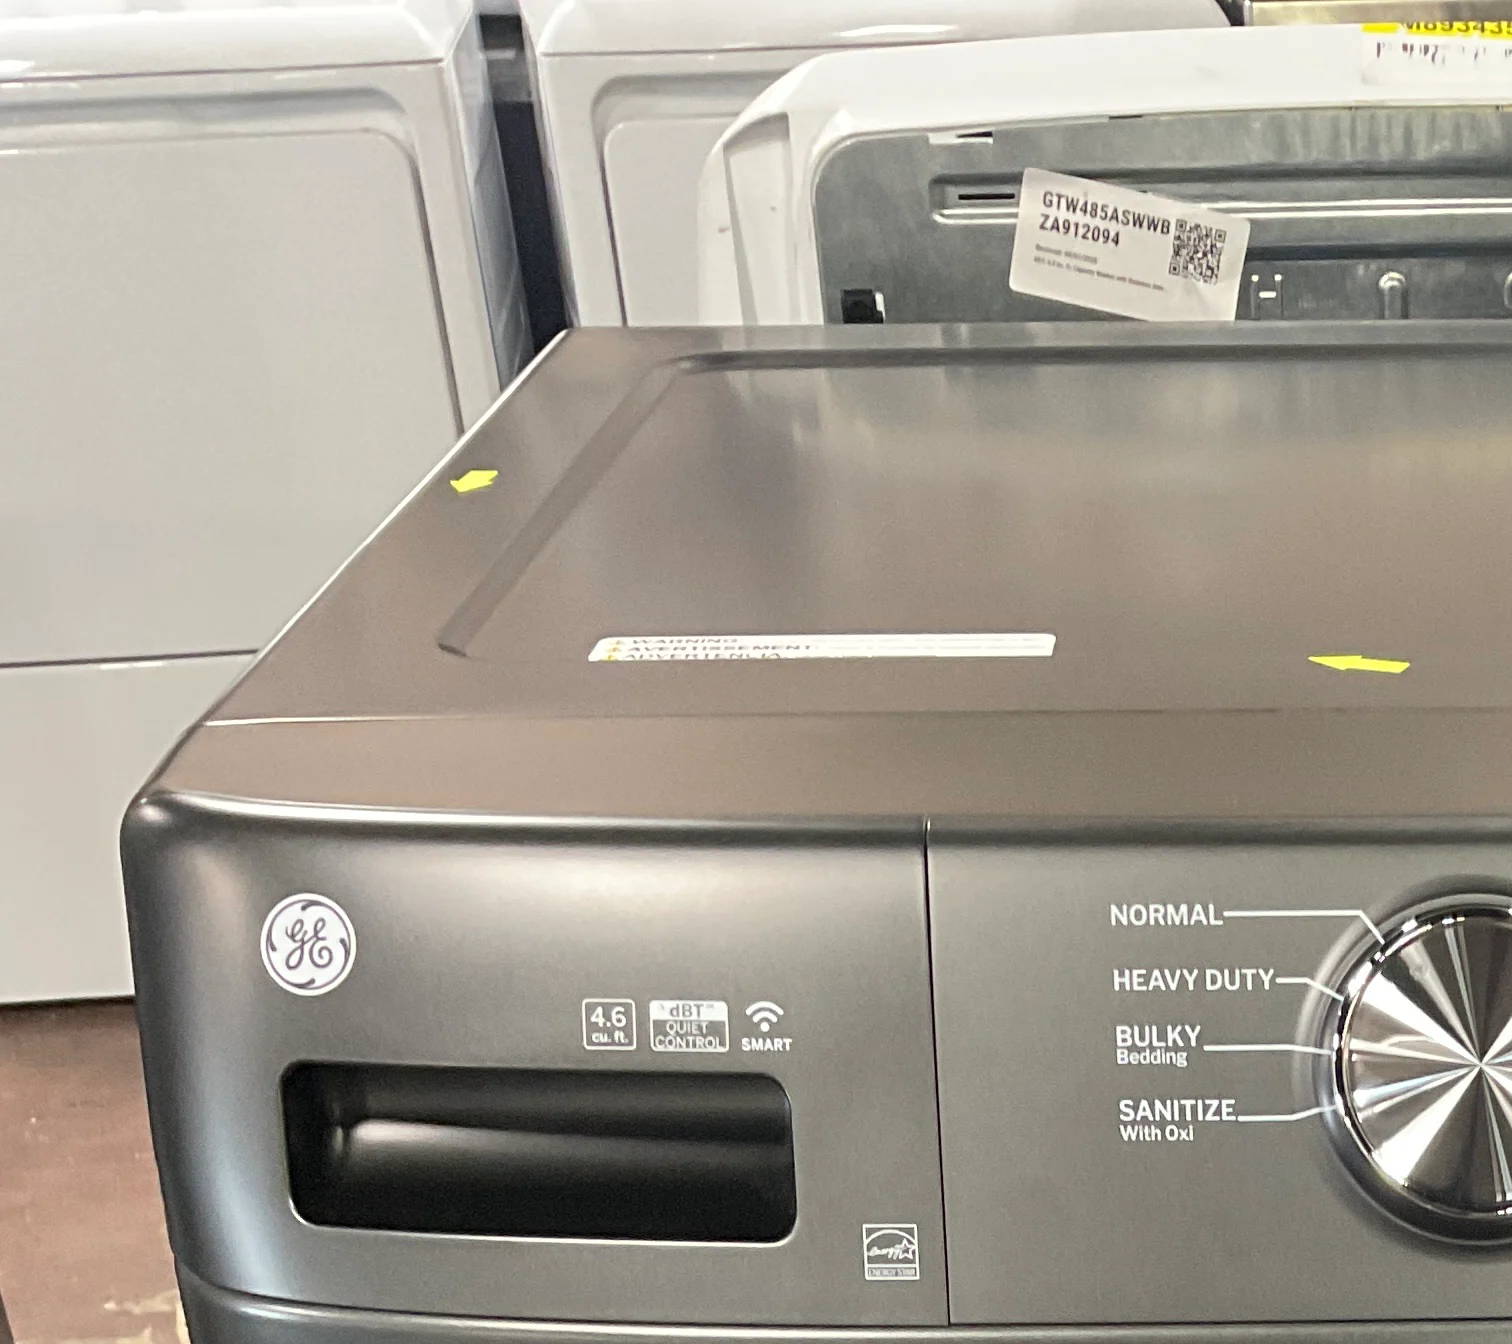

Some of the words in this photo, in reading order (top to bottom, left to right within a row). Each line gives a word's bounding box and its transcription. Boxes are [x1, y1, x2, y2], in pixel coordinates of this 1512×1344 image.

[1042, 190, 1170, 235] GTW485ASWWB
[1038, 213, 1120, 247] ZA912094
[1110, 904, 1224, 926] NORMAL
[1112, 969, 1199, 991] HEAVY
[1205, 969, 1274, 991] DUTY
[590, 1006, 627, 1028] 4.6
[666, 1021, 709, 1035] QUIET
[591, 1033, 611, 1043] cu.
[655, 1036, 725, 1050] CONTROL
[741, 1037, 793, 1051] SMART
[1115, 1025, 1201, 1047] BULKY
[1116, 1048, 1188, 1067] Bedding
[1118, 1099, 1237, 1122] SANITIZE
[1119, 1125, 1162, 1141] With
[1165, 1125, 1194, 1141] Oxi
